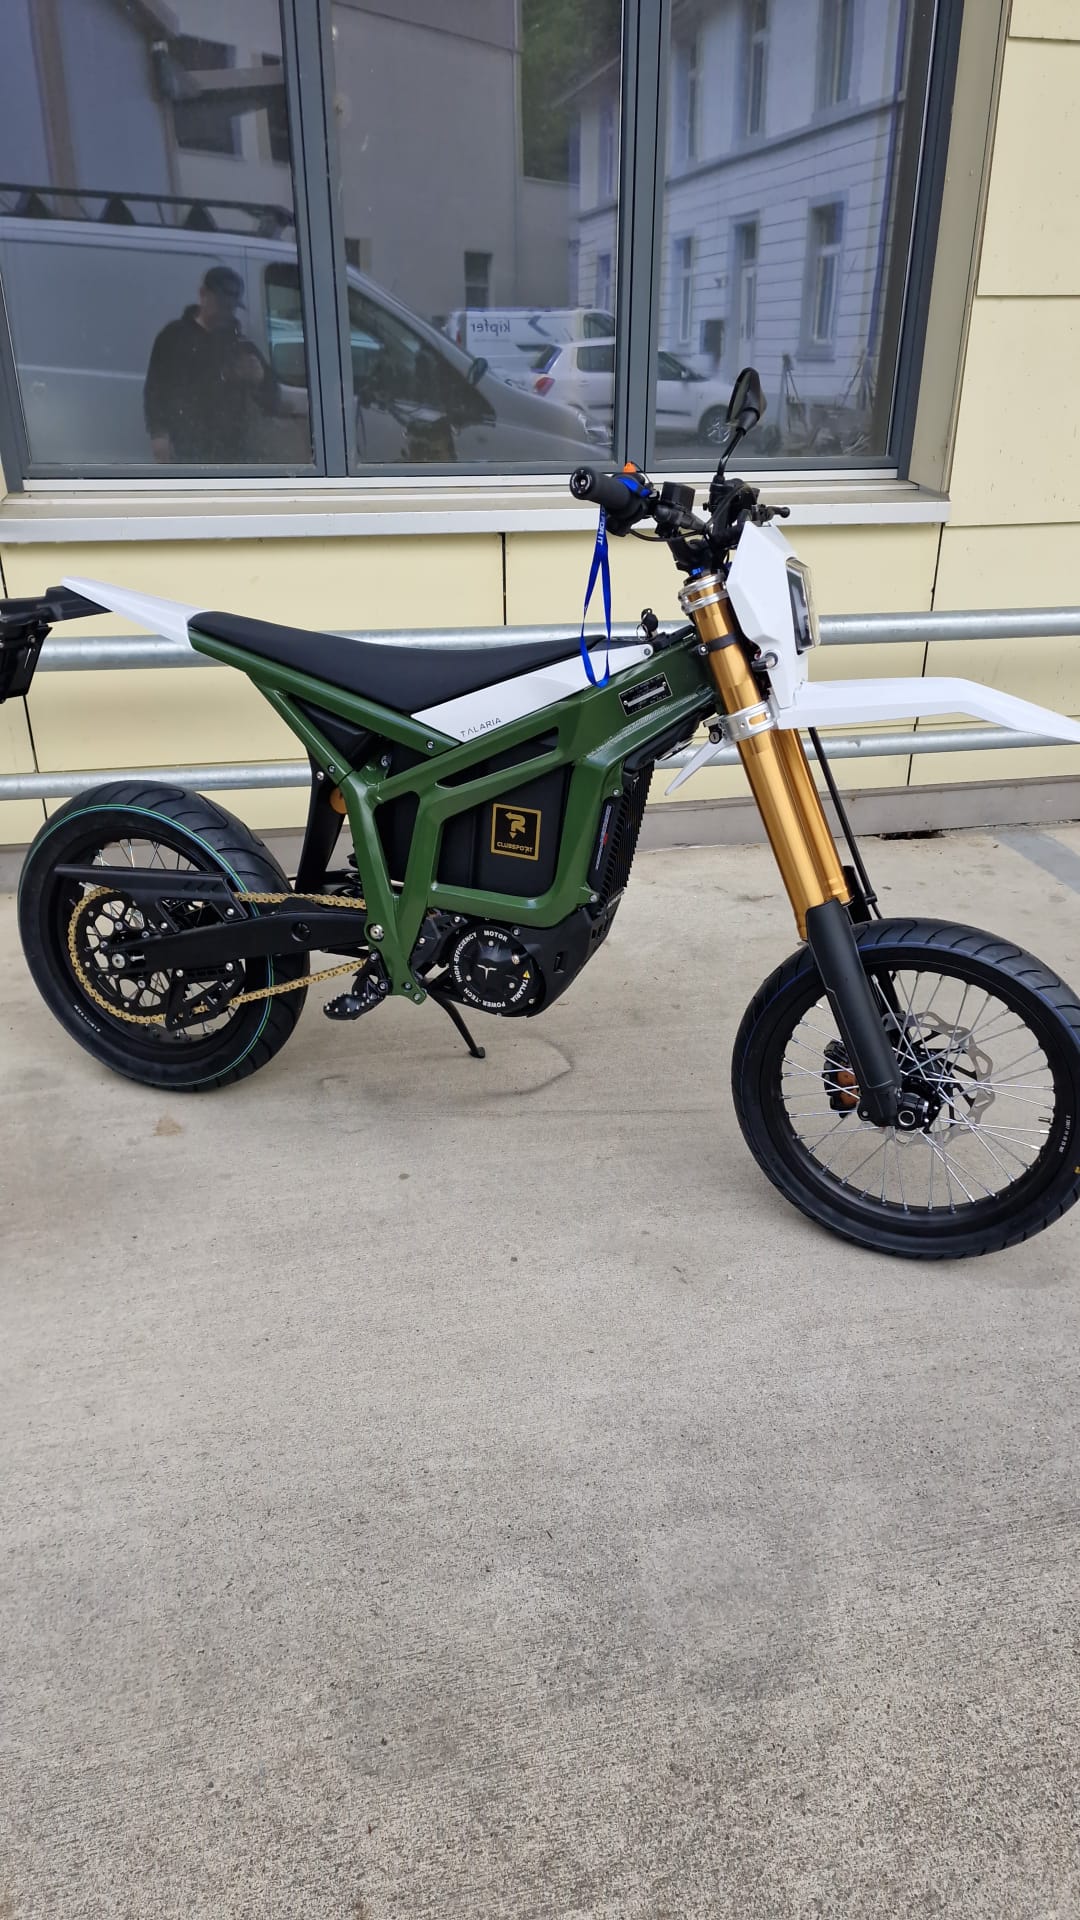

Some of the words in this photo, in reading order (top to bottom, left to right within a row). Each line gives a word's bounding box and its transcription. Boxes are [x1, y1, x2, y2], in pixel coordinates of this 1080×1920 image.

[460, 717, 502, 737] TALARIA
[497, 841, 533, 853] CLUBSPORT
[484, 930, 508, 942] MOTOR
[511, 980, 528, 1002] TALARIA
